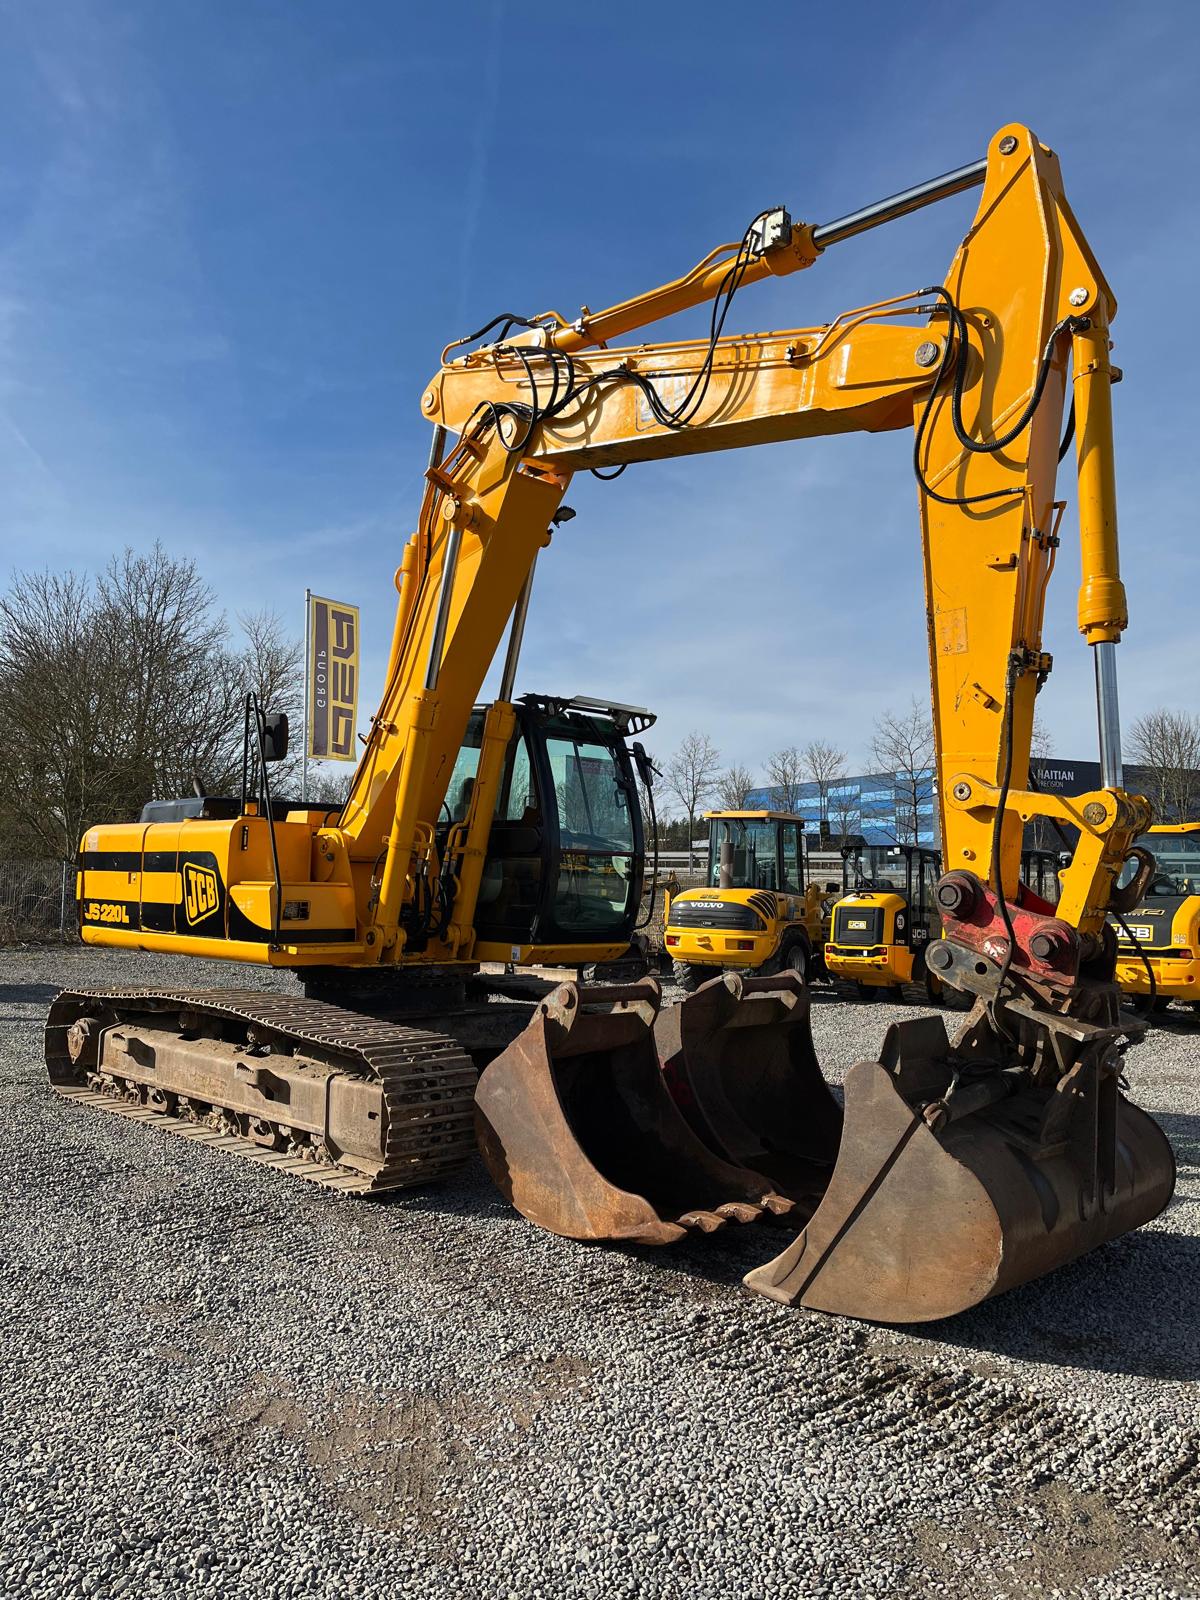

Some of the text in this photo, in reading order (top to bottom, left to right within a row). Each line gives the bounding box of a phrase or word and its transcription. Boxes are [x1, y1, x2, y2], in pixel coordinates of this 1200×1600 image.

[1037, 769, 1074, 781] HAITIAN
[187, 869, 216, 919] JCB
[690, 901, 724, 909] VOLVO
[912, 928, 927, 939] JCB
[1113, 926, 1150, 938] JCB
